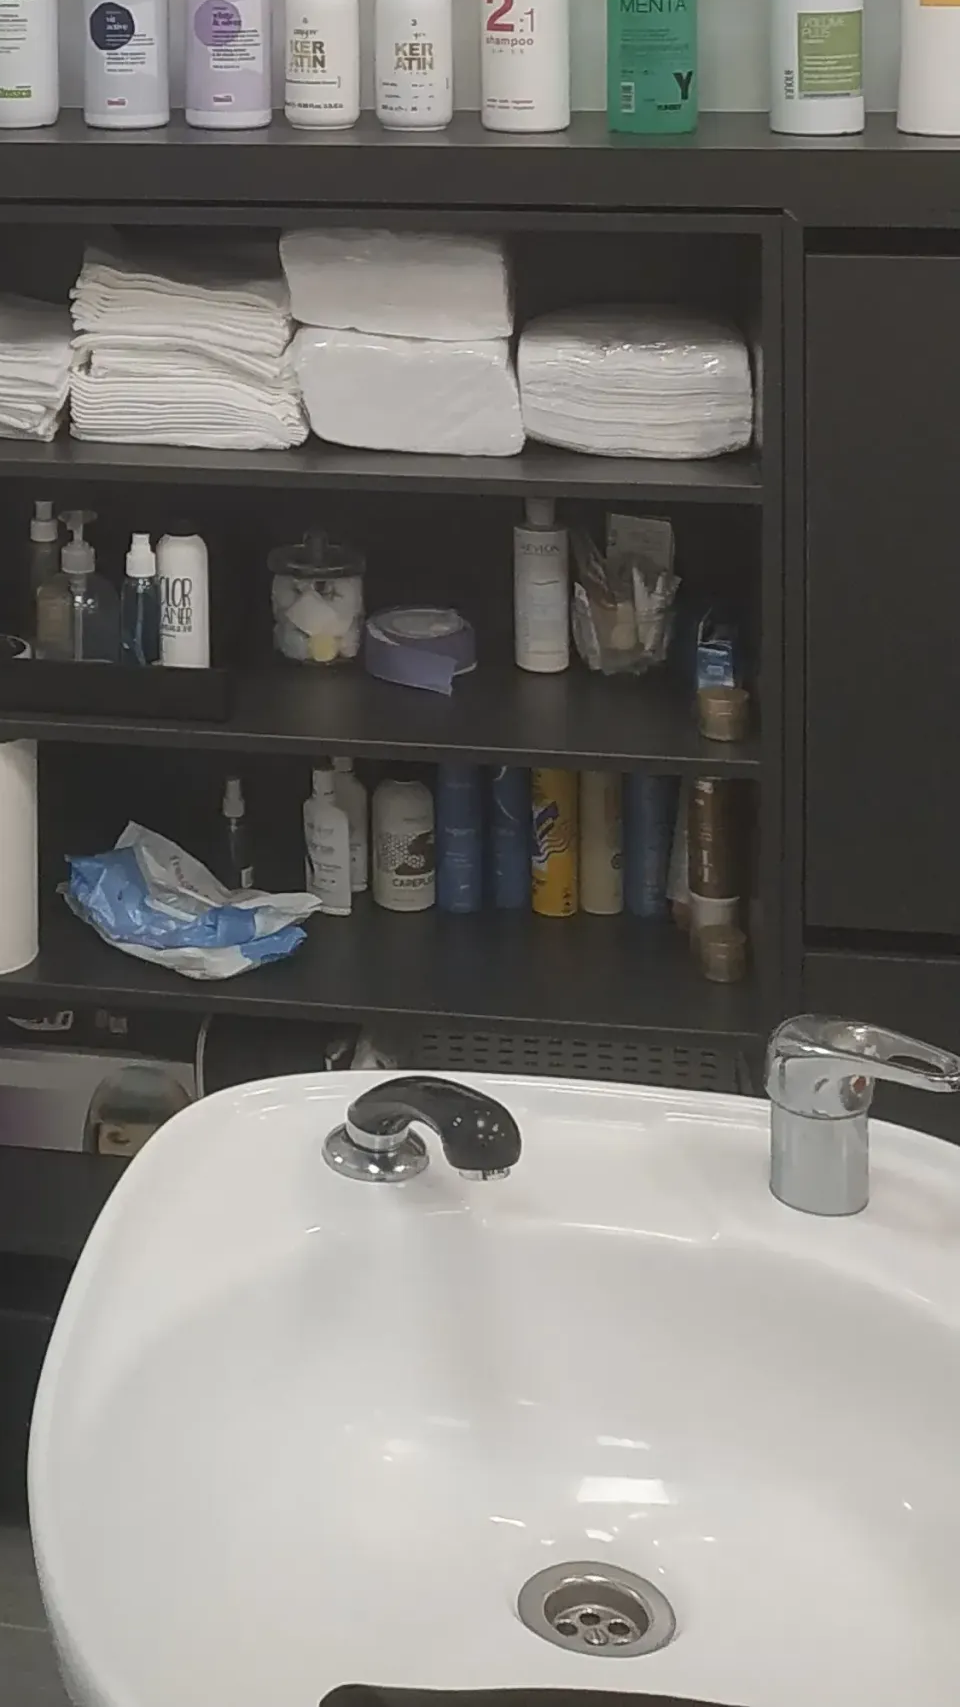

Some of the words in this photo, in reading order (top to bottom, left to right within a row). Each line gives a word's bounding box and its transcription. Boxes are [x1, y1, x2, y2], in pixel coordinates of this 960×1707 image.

[486, 36, 535, 47] shampoo
[394, 42, 433, 56] KER
[394, 57, 434, 71] ATIN
